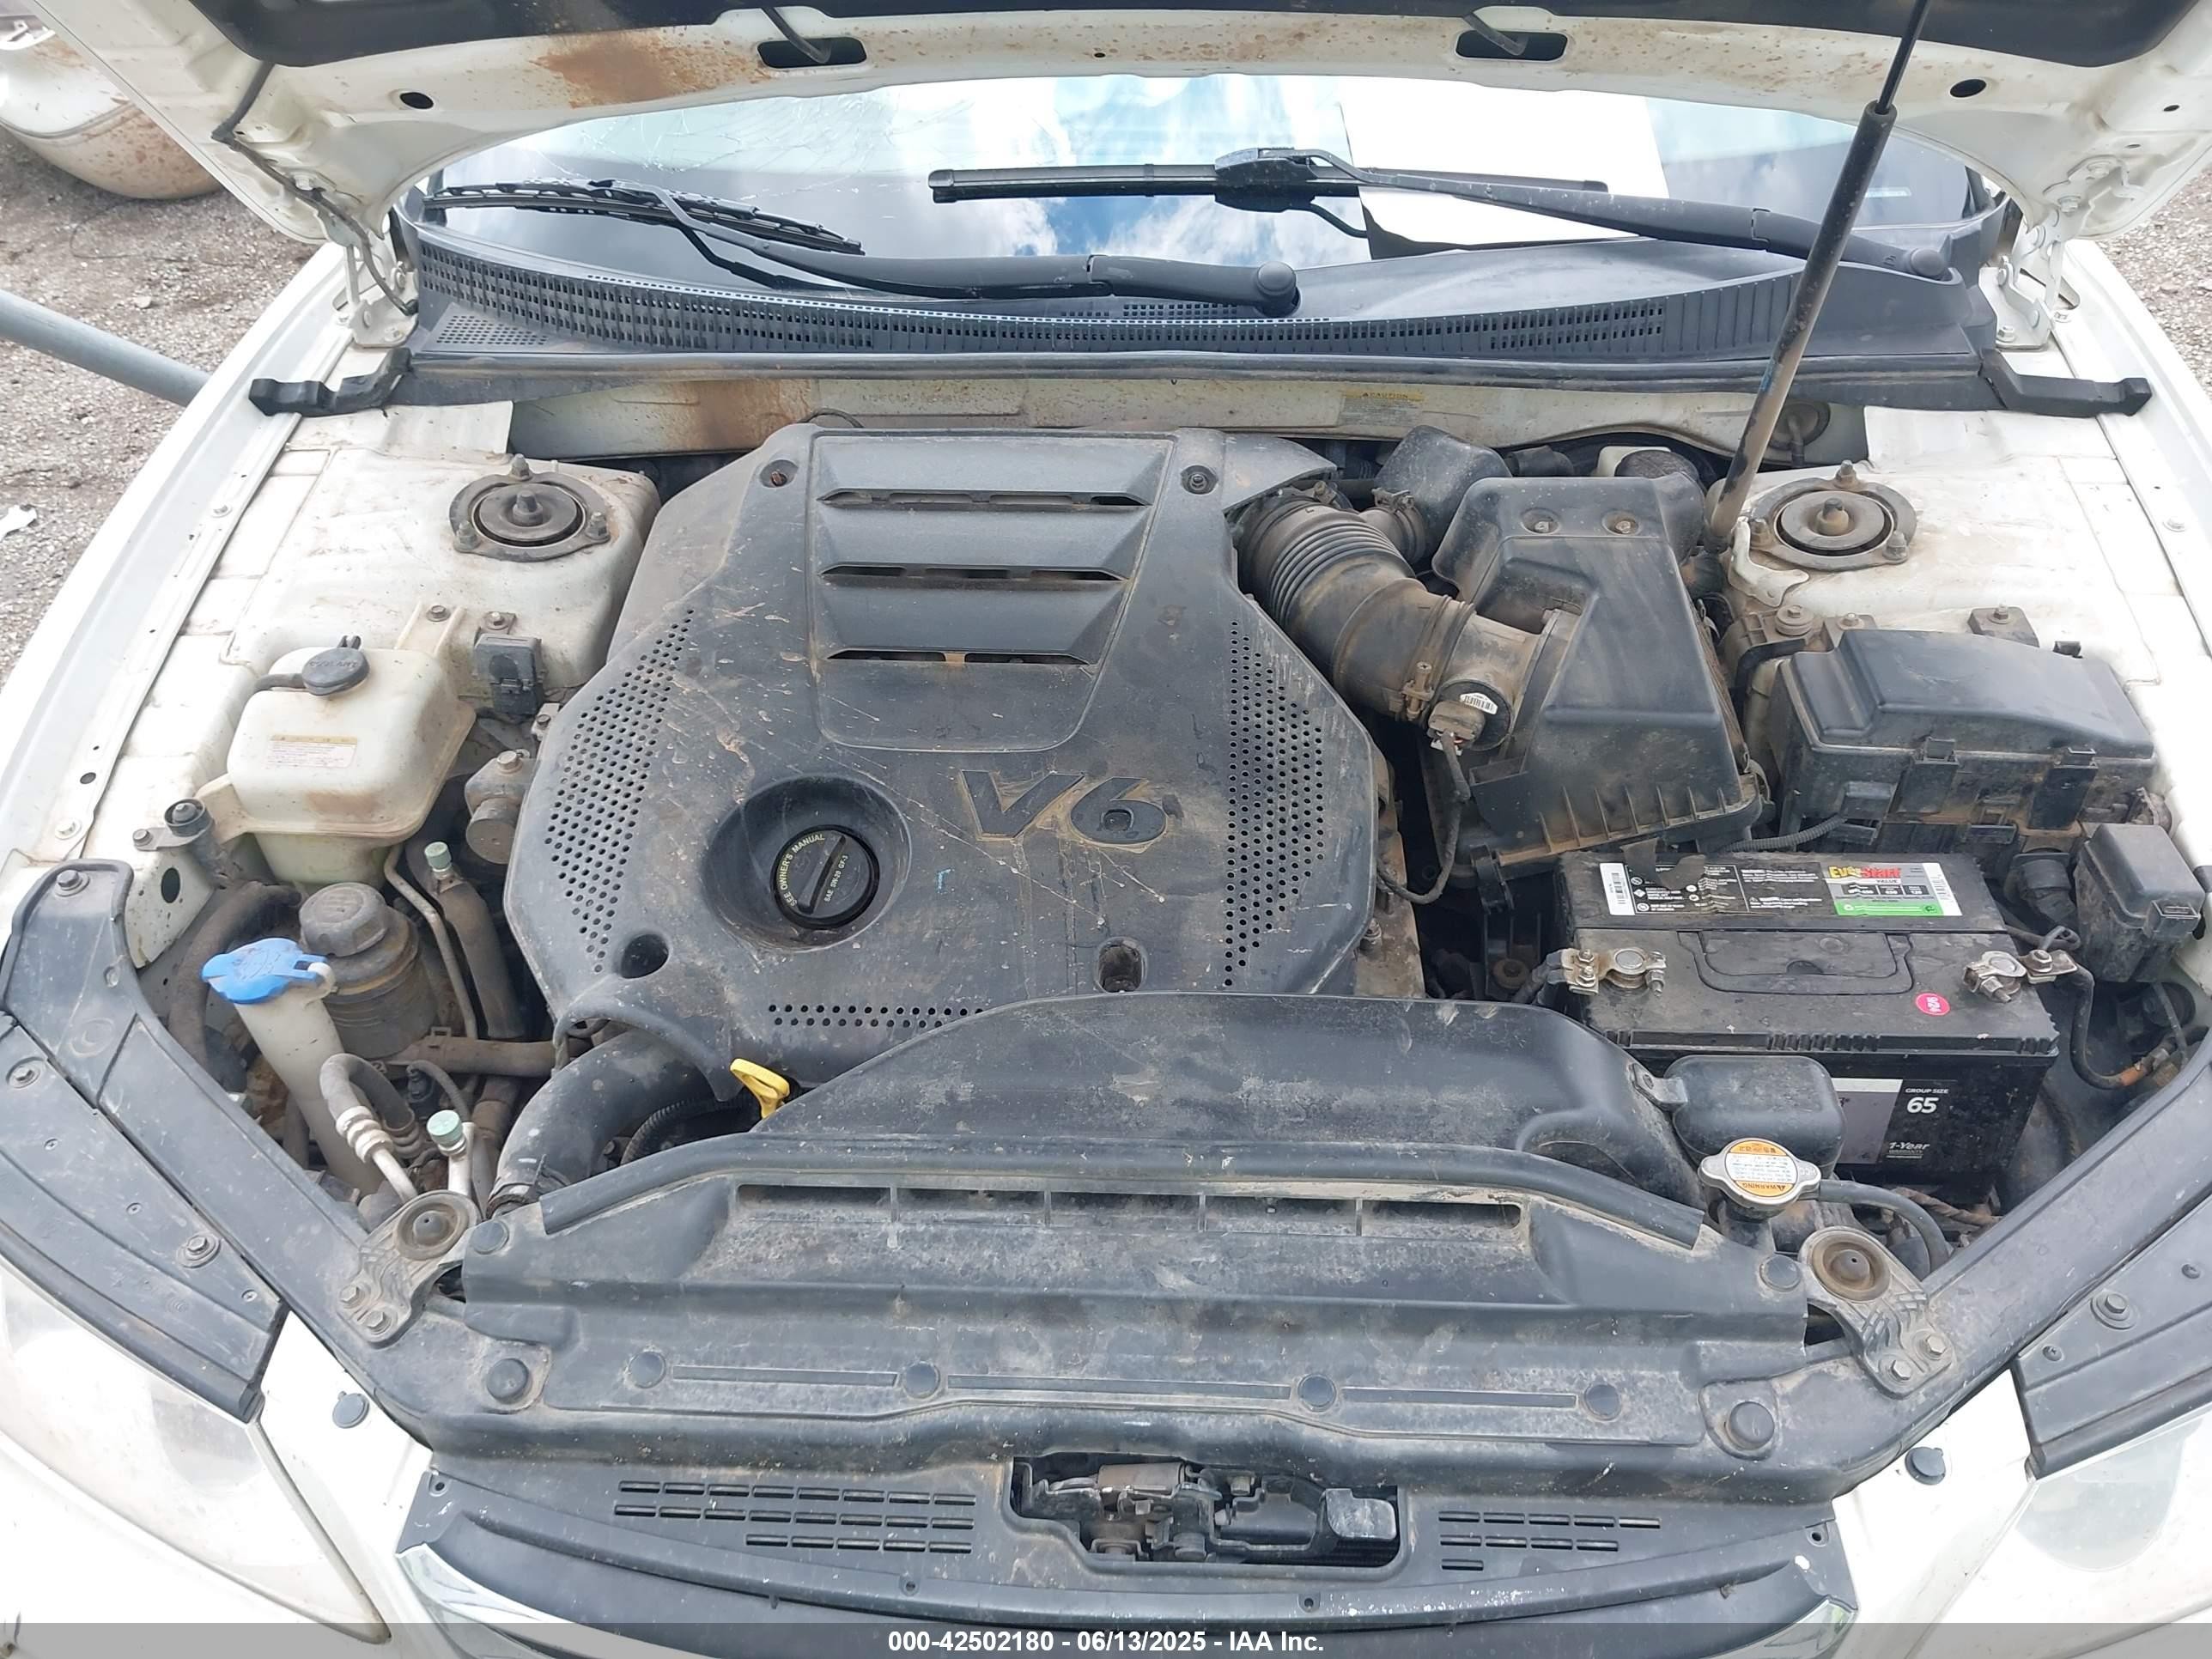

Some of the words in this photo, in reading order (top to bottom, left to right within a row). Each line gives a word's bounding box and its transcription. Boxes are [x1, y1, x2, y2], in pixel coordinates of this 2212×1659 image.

[960, 769, 1168, 845] V6
[791, 833, 825, 854] MANUAL
[780, 853, 793, 890] OWNER'S
[783, 891, 797, 907] SEE
[1906, 1097, 1939, 1114] 65
[1888, 1141, 1930, 1150] 1-Year
